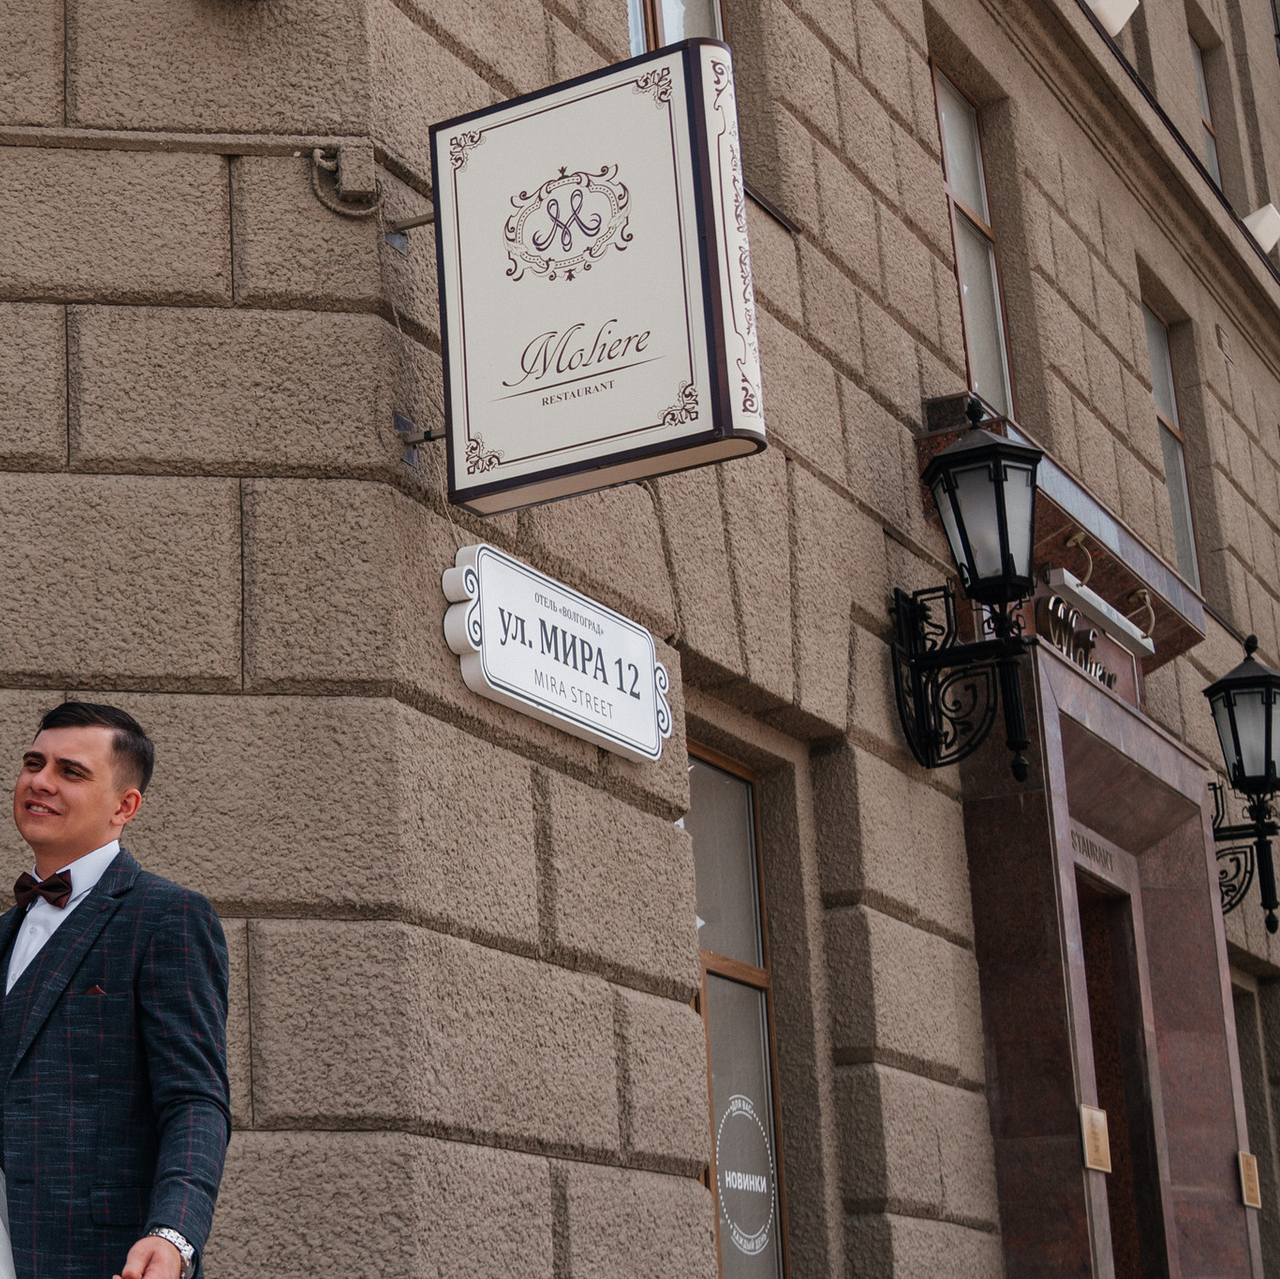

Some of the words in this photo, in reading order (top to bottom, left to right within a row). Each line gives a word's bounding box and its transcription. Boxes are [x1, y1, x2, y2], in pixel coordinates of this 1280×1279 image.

[502, 319, 651, 388] Moliere
[541, 380, 615, 407] RESTAURANT
[534, 592, 558, 613] ОТЕЛЬ
[559, 606, 604, 636] «ВОЛГОГРАД»
[538, 617, 609, 685] МИРА
[614, 657, 641, 700] 12
[534, 668, 567, 699] MIRA
[571, 686, 613, 719] STREET
[725, 1169, 767, 1194] НОВИНКИ
